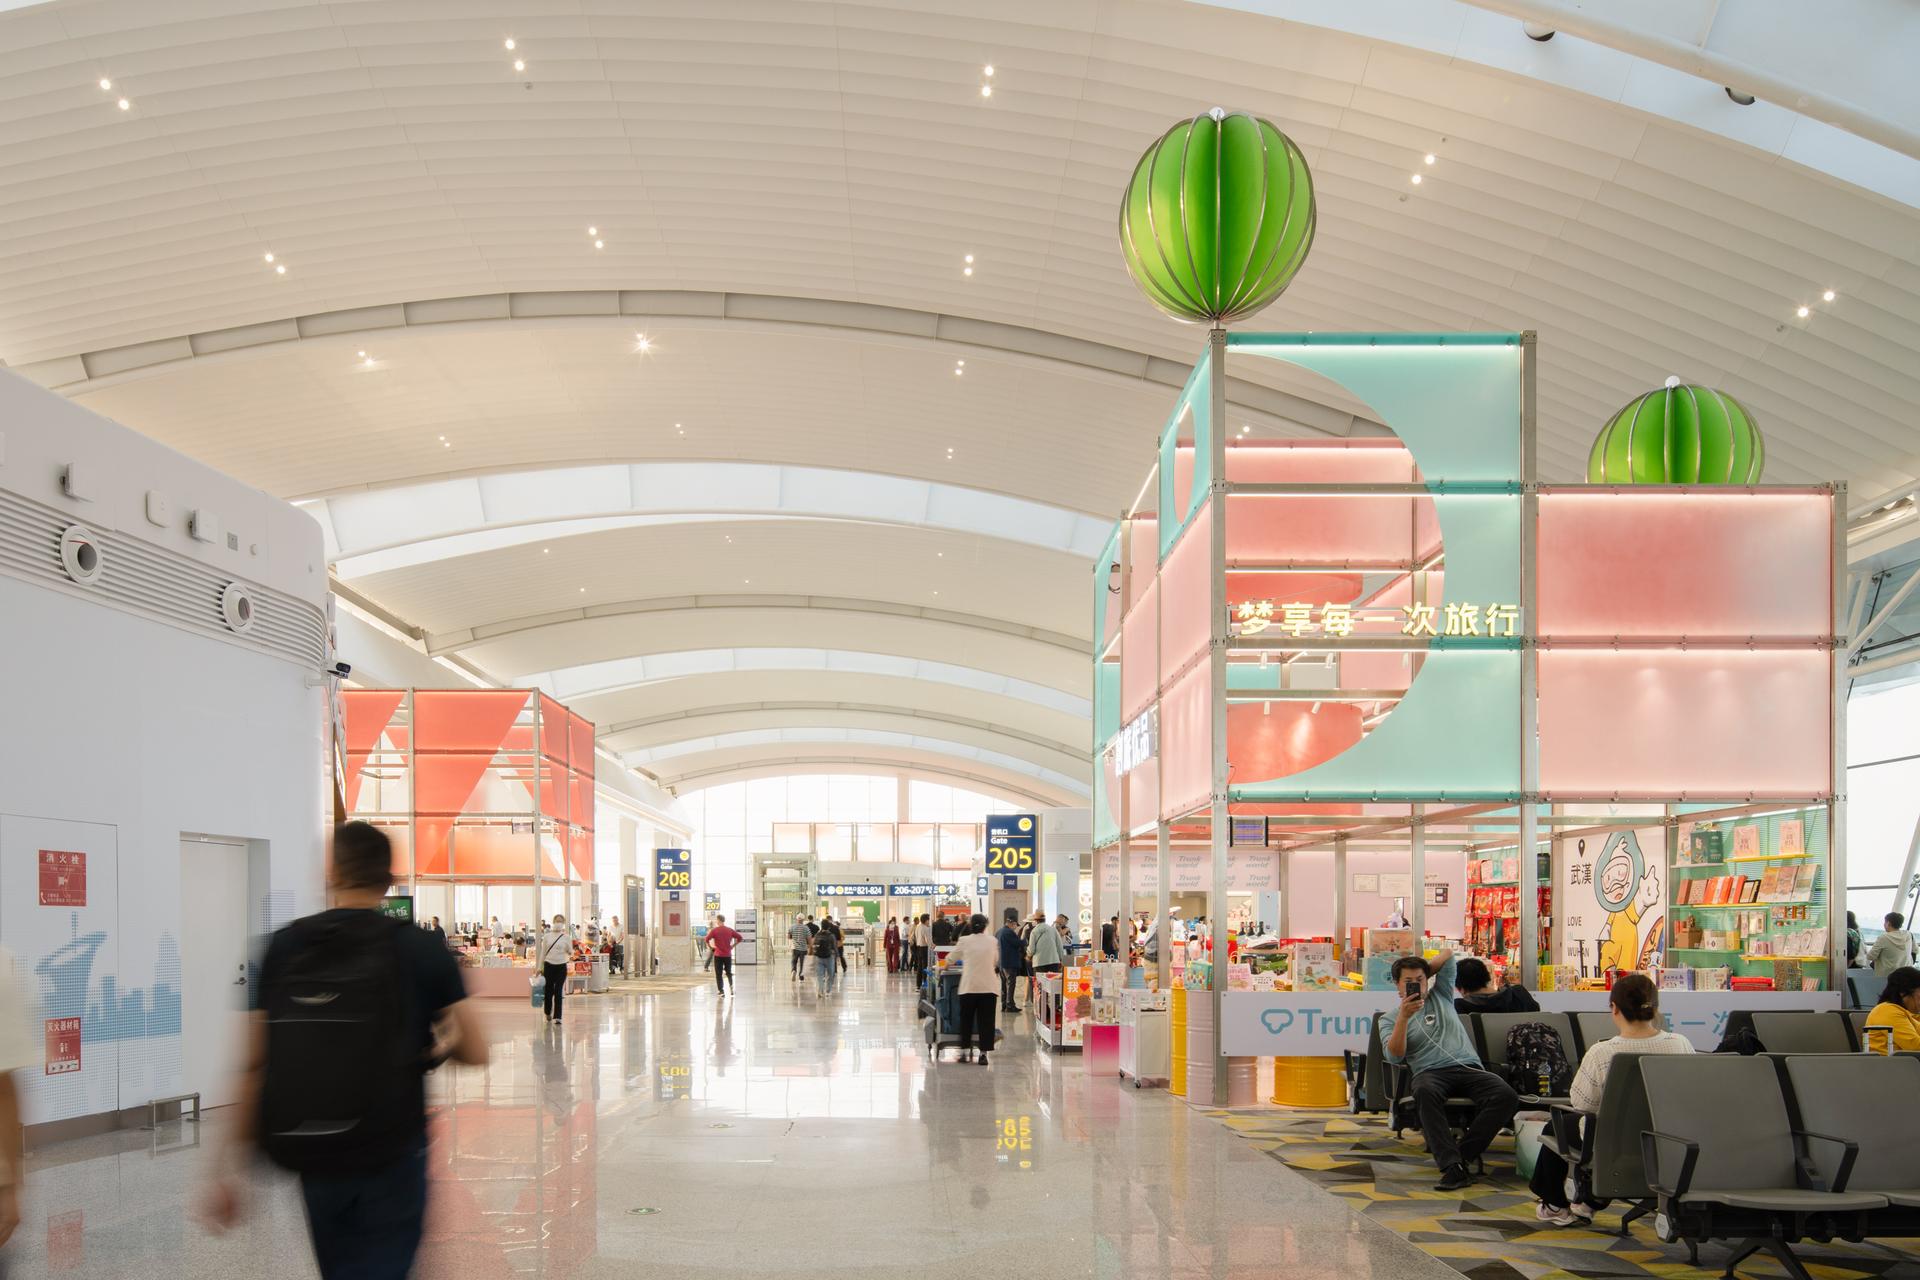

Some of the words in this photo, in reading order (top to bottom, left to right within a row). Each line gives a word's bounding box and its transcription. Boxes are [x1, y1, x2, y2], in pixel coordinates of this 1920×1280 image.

[1237, 601, 1519, 637] 梦享每一次旅行
[46, 853, 80, 865] 消火栓
[988, 847, 1032, 869] 205
[659, 871, 690, 887] 208
[1570, 863, 1592, 885] 武漢
[857, 886, 882, 895] 821-824
[894, 886, 925, 895] 206-207
[706, 902, 720, 910] 207
[1567, 916, 1582, 927] LOVE
[1067, 981, 1079, 993] 我
[1298, 1008, 1374, 1035] Trun
